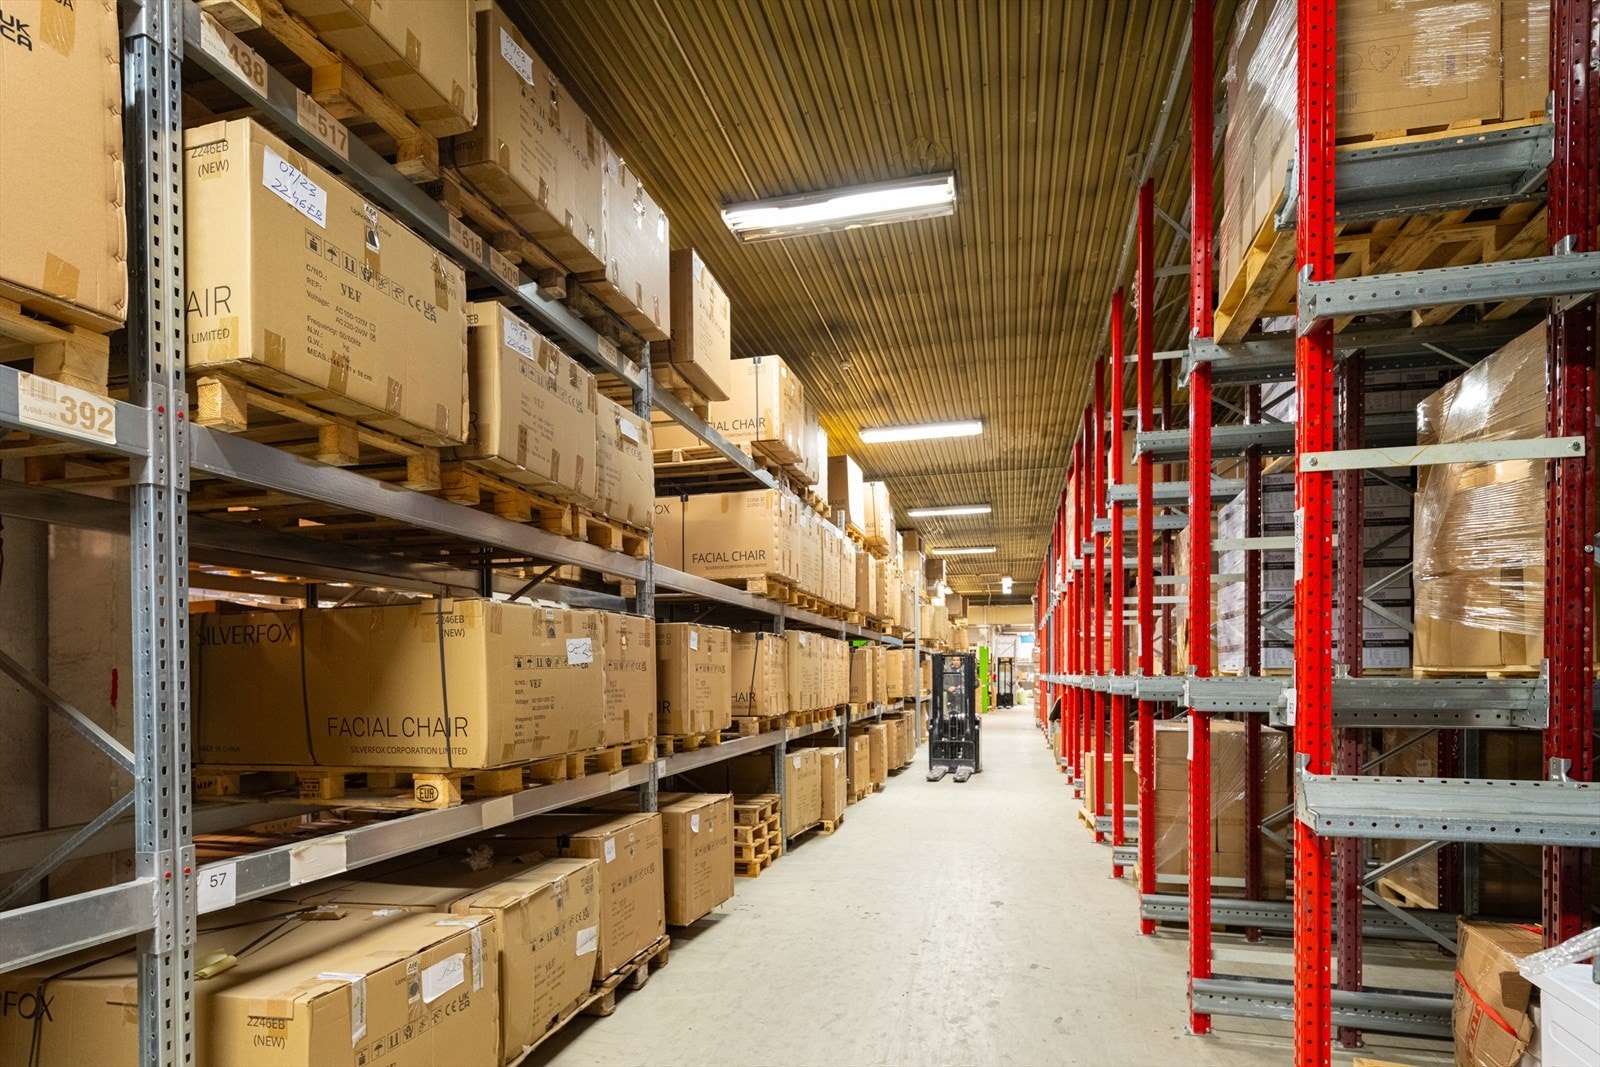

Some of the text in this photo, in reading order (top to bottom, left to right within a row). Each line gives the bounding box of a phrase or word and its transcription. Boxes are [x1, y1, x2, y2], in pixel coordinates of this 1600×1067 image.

[317, 113, 347, 151] 517
[191, 141, 229, 159] 2246EB
[197, 159, 229, 178] (NEW)
[279, 161, 318, 198] 07/23
[271, 177, 323, 221] 2246EB
[462, 232, 481, 258] 518
[191, 327, 230, 345] LIMITED
[60, 395, 113, 435] 392
[692, 549, 766, 564] FACIAL CHAIR
[197, 622, 295, 647] SILVERFOX
[327, 716, 468, 738] FACIAL CHAIR
[350, 745, 386, 755] SILVERFOX
[386, 745, 438, 756] CORPORATION
[419, 788, 435, 799] EUR
[209, 872, 227, 888] 57
[253, 1033, 286, 1049] (NEW)
